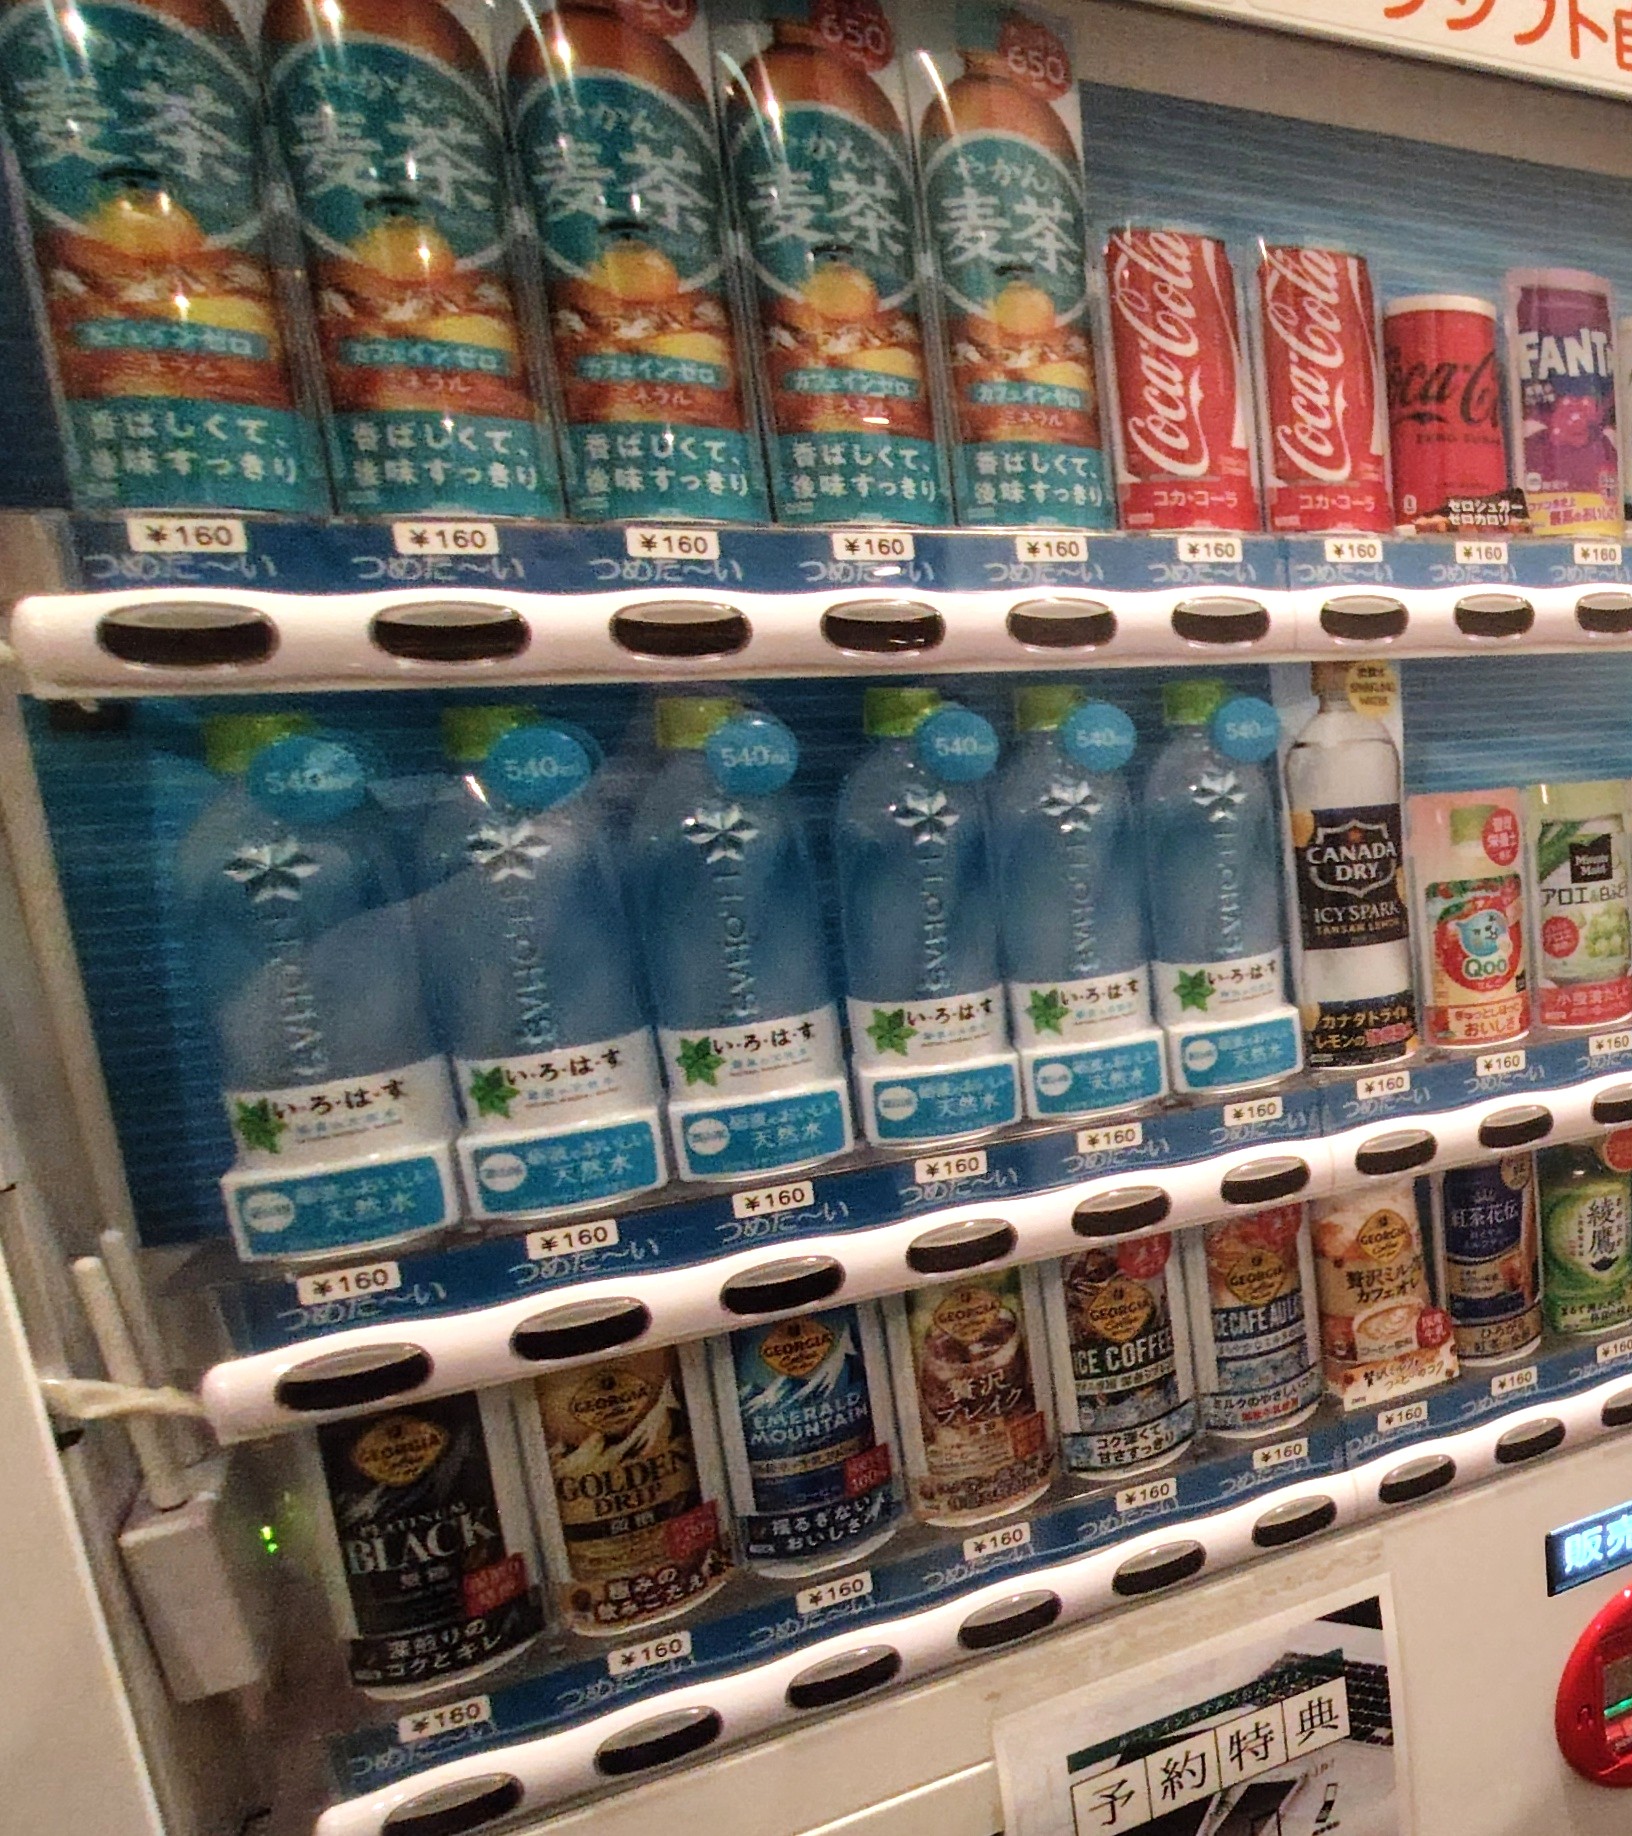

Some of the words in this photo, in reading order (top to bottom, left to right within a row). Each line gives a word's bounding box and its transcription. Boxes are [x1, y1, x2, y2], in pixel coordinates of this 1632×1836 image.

[533, 142, 707, 232] 麦茶
[748, 169, 905, 257] 麦茶
[941, 188, 1080, 276] 麦茶
[1116, 228, 1210, 479] Coca-Cola
[1262, 247, 1352, 481] Coca-Cola
[1519, 328, 1614, 379] FANT
[148, 525, 233, 548] ¥160
[410, 528, 487, 549] ¥160
[640, 534, 708, 554] ¥160
[845, 538, 905, 557] ¥160
[1027, 540, 1080, 558] ¥160
[1187, 541, 1236, 559] ¥160
[1333, 543, 1377, 559] ¥160
[1461, 545, 1503, 561] ¥160
[1580, 547, 1617, 563] ¥160
[1307, 841, 1397, 865] CANADA
[1335, 863, 1379, 882] DRY
[1314, 906, 1345, 926] ICY
[1462, 956, 1509, 978] Qoo
[1597, 1036, 1629, 1051] ¥160
[1484, 1054, 1520, 1070] ¥160
[1365, 1076, 1404, 1094] ¥160
[1232, 1101, 1278, 1119] ¥160
[1086, 1128, 1136, 1147] ¥160
[926, 1156, 980, 1176] ¥160
[744, 1187, 806, 1210] ¥160
[1450, 1200, 1519, 1228] 紅茶花伝
[1587, 1196, 1616, 1254] 綾鷹
[539, 1226, 609, 1252] ¥160
[313, 1268, 389, 1296] ¥160
[1498, 1370, 1533, 1387] ¥160
[753, 1392, 861, 1430] EMERALD
[1385, 1406, 1423, 1425] ¥160
[751, 1404, 868, 1445] MOUNTAIN
[1261, 1444, 1303, 1462] ¥160
[555, 1451, 692, 1502] GOLDEN
[1124, 1484, 1170, 1503] ¥160
[350, 1512, 496, 1574] BLACK
[974, 1530, 1023, 1552] ¥160
[809, 1578, 865, 1605] ¥160
[621, 1638, 682, 1666] ¥160
[411, 1703, 480, 1734] ¥160
[1088, 1695, 1341, 1826] 予約特典
